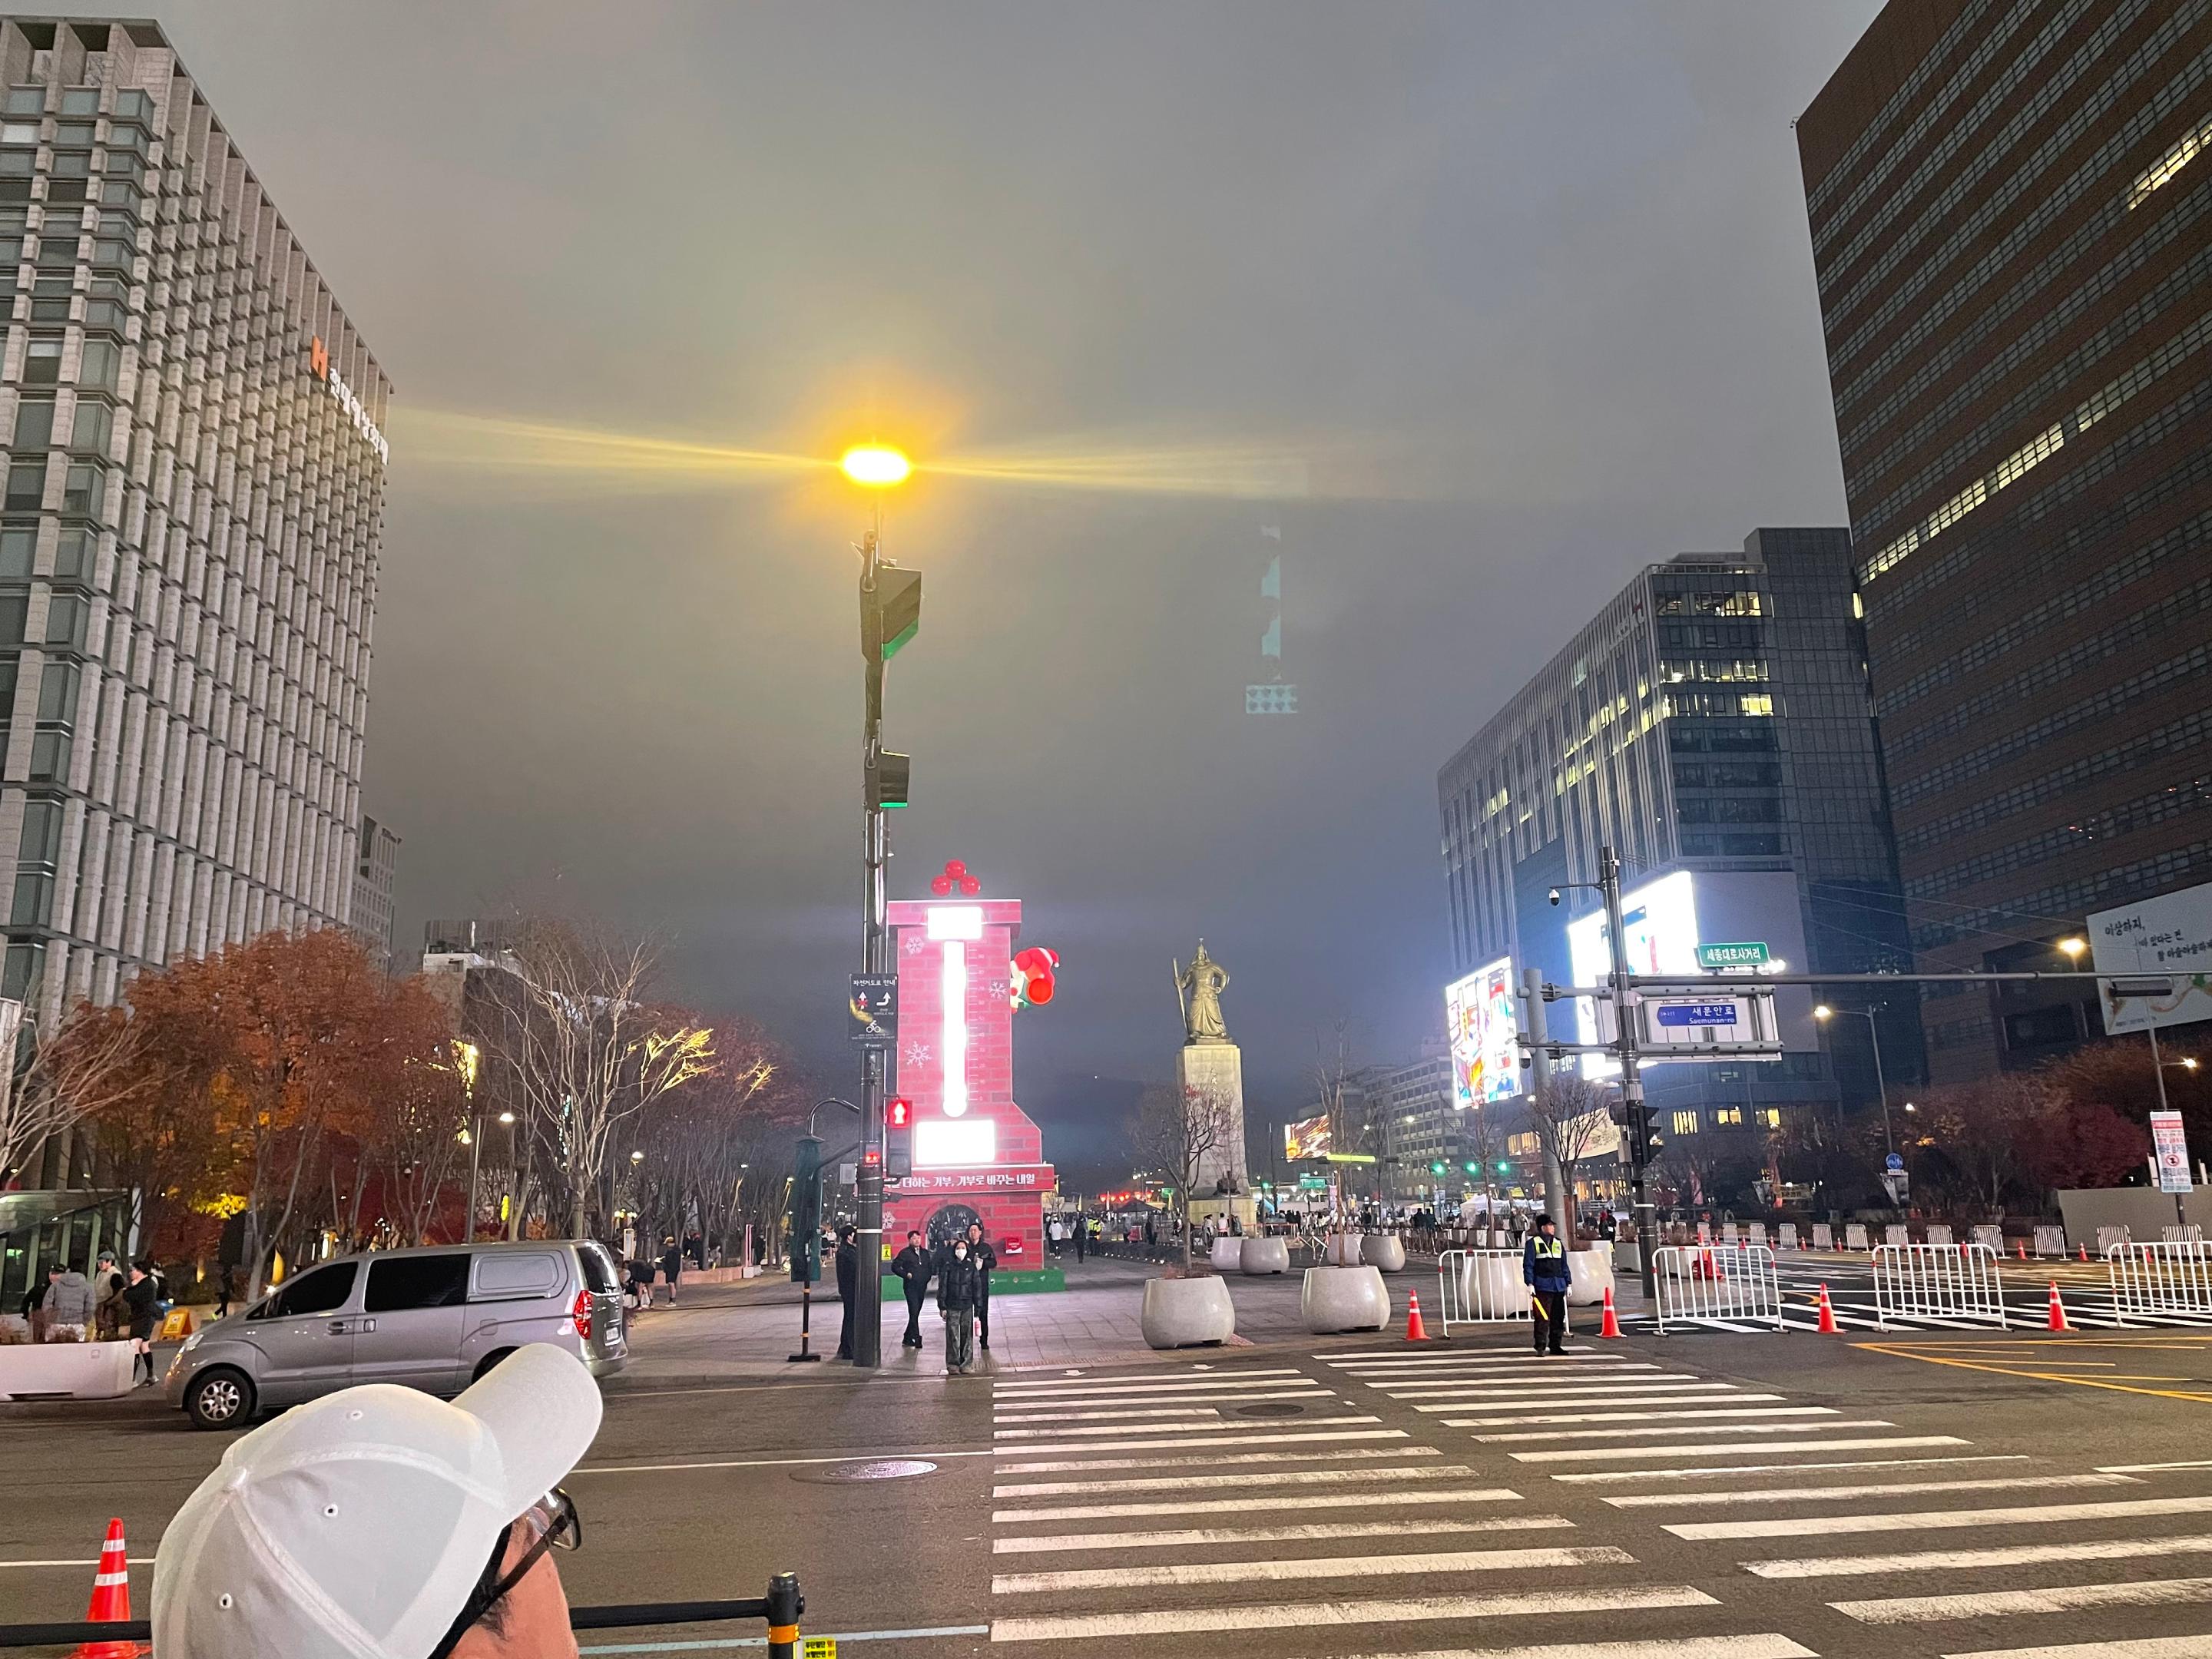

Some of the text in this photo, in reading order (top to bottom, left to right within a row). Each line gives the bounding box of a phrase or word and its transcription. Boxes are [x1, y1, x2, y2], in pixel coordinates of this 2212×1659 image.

[1707, 947, 1761, 961] 세종대로사거리
[1692, 1006, 1734, 1016] 새문안로
[902, 1177, 932, 1188] 더하는
[932, 1176, 955, 1187] 기부,
[958, 1175, 985, 1187] 기부로
[987, 1174, 1015, 1186] 바꾸는
[1016, 1174, 1035, 1184] 내일
